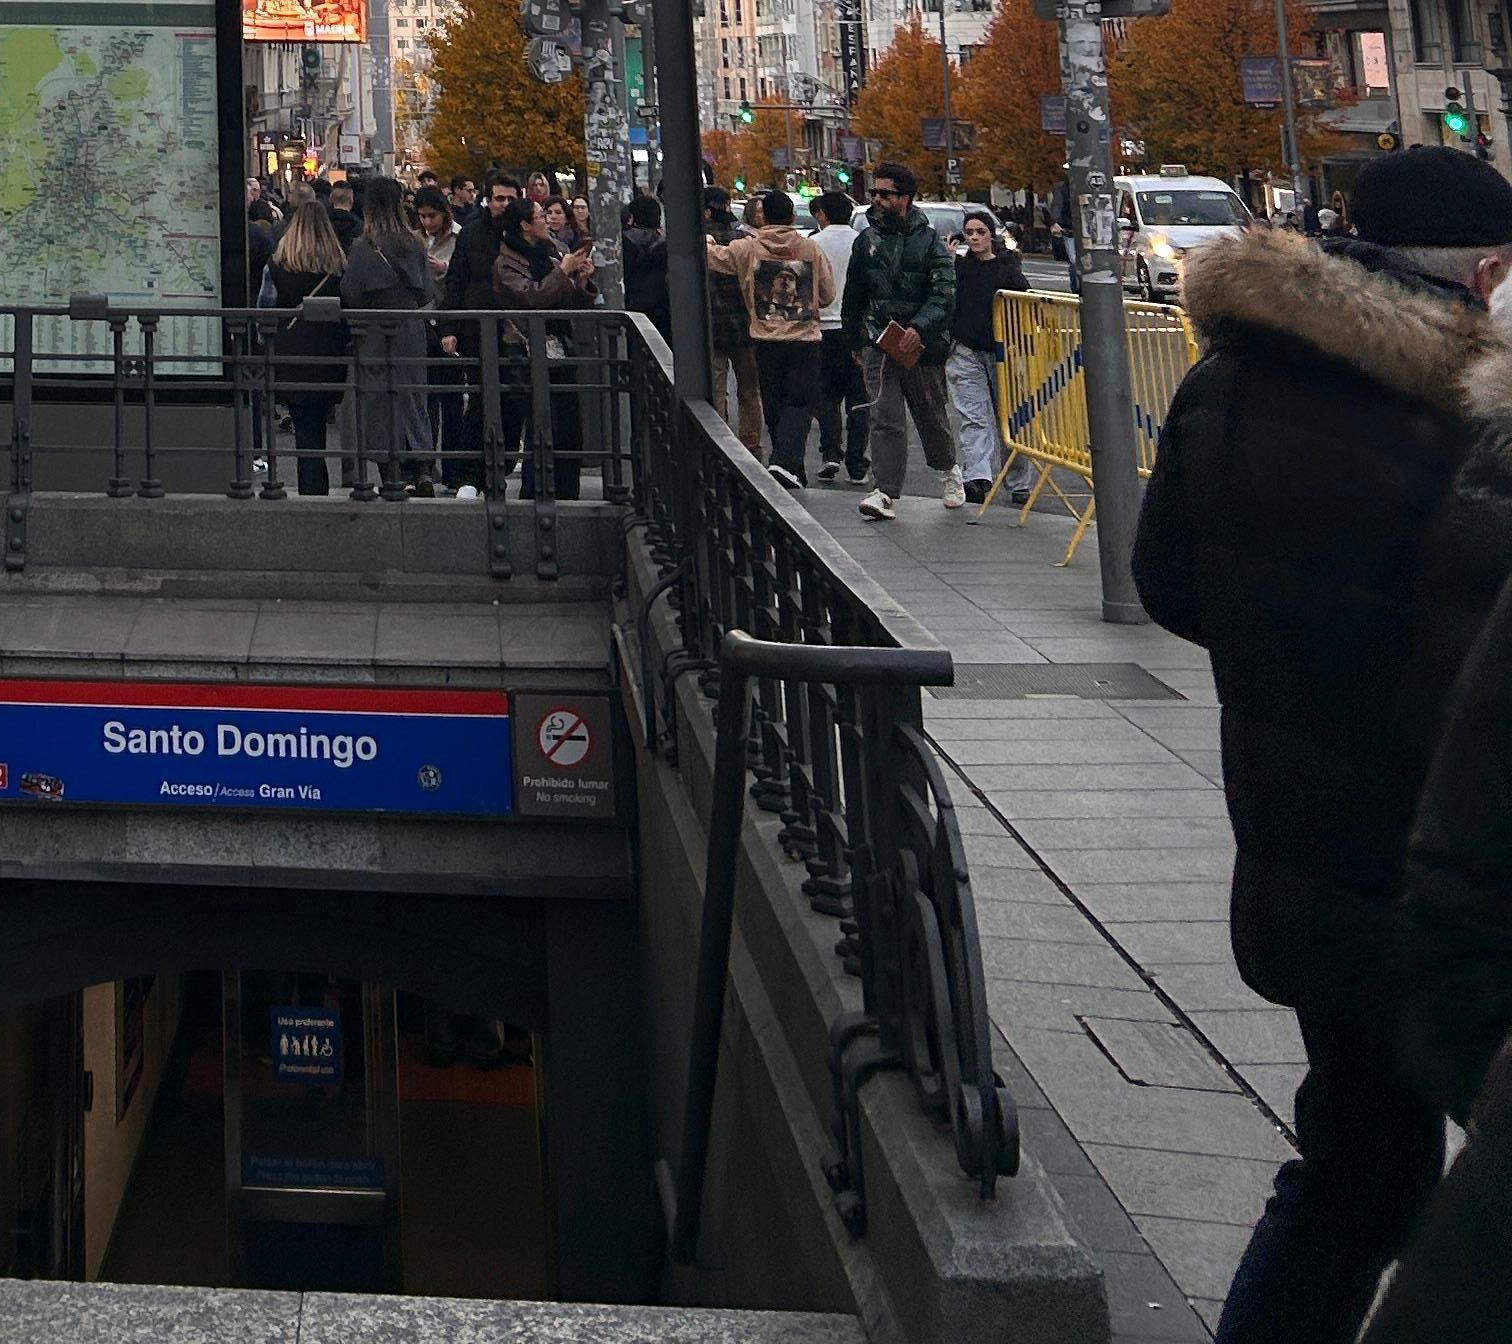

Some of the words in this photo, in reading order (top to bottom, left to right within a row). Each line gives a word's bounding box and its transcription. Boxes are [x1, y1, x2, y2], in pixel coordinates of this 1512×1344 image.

[947, 159, 958, 170] P
[103, 720, 205, 756] Santo
[217, 724, 378, 768] Domingo
[523, 776, 576, 788] Prohibido
[578, 778, 609, 790] fumar
[259, 783, 295, 799] Gran
[298, 785, 321, 800] Vía
[536, 792, 551, 802] No
[552, 793, 597, 806] smoking
